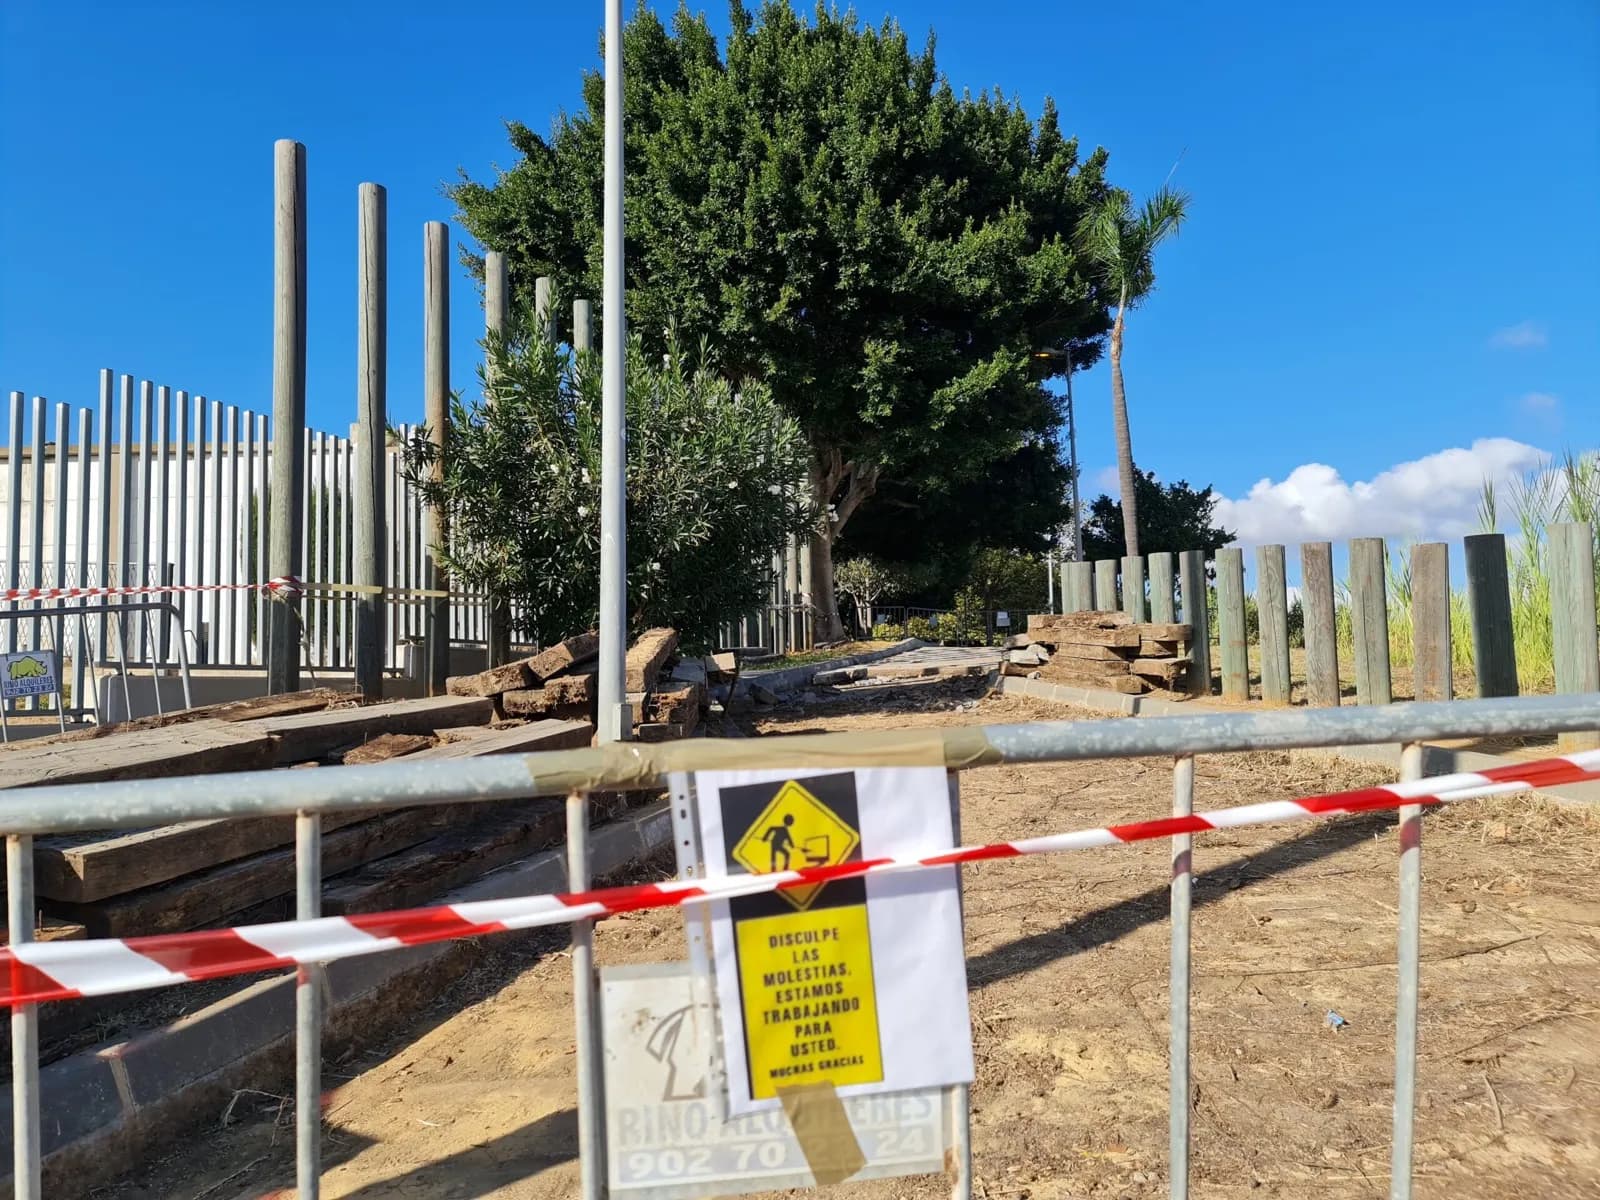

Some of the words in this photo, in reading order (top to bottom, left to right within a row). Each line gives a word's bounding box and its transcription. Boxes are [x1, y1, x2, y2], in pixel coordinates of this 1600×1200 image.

[768, 927, 840, 949] DISCULPE
[792, 948, 820, 964] LAS
[775, 981, 844, 1004] ESTAMOS
[762, 996, 860, 1025] TRABAJANDO
[794, 1020, 832, 1038] PARA
[769, 1062, 815, 1079] MUCHAS
[818, 1055, 864, 1071] GRACIAS
[618, 1102, 708, 1147] RINO
[720, 1092, 932, 1137] ALQERES
[627, 1148, 712, 1179] 902
[734, 1140, 788, 1170] 70
[875, 1128, 926, 1158] 24
